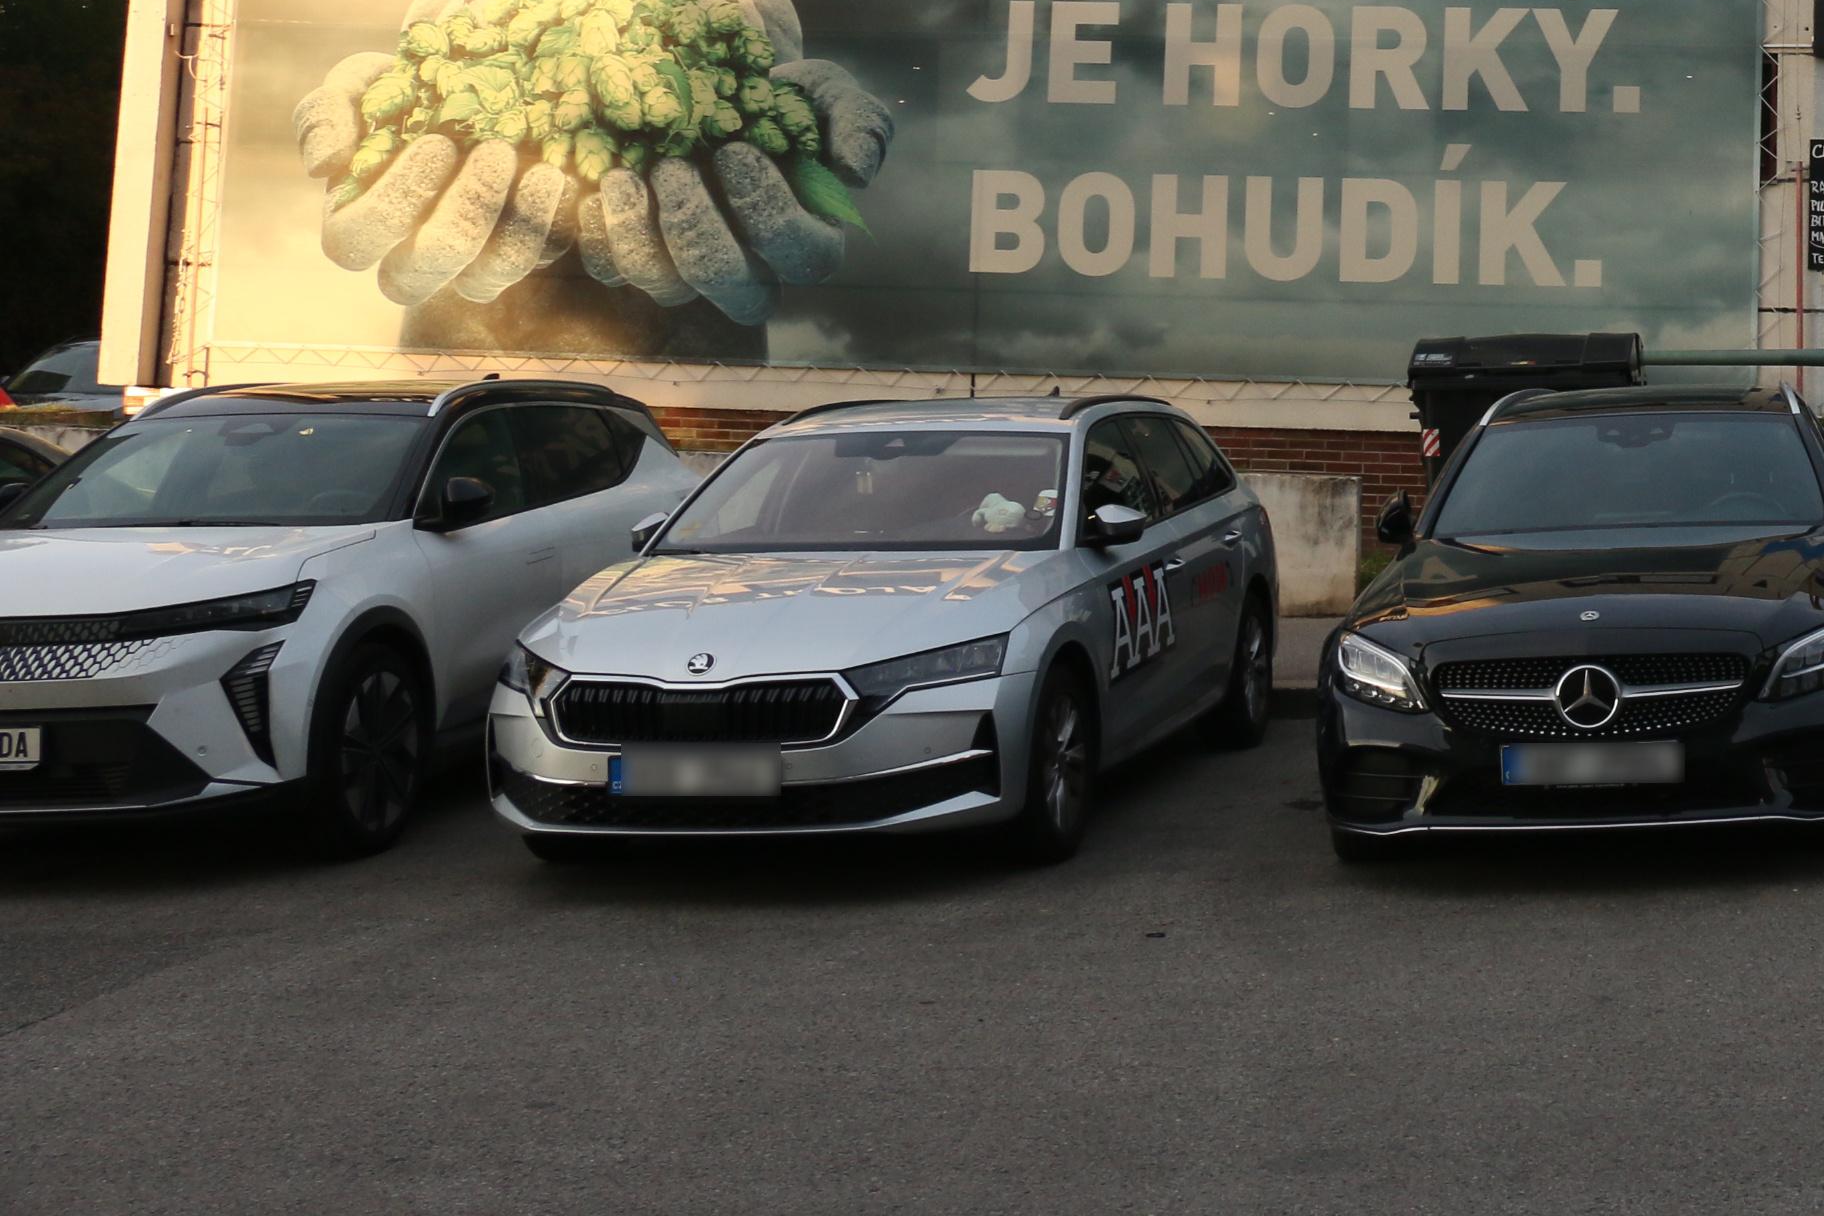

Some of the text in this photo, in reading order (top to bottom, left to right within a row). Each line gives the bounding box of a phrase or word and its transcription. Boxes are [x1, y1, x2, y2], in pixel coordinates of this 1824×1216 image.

[967, 0, 1120, 103] JE
[968, 144, 1602, 287] BOHUDÍK.
[1111, 567, 1176, 680] AAA
